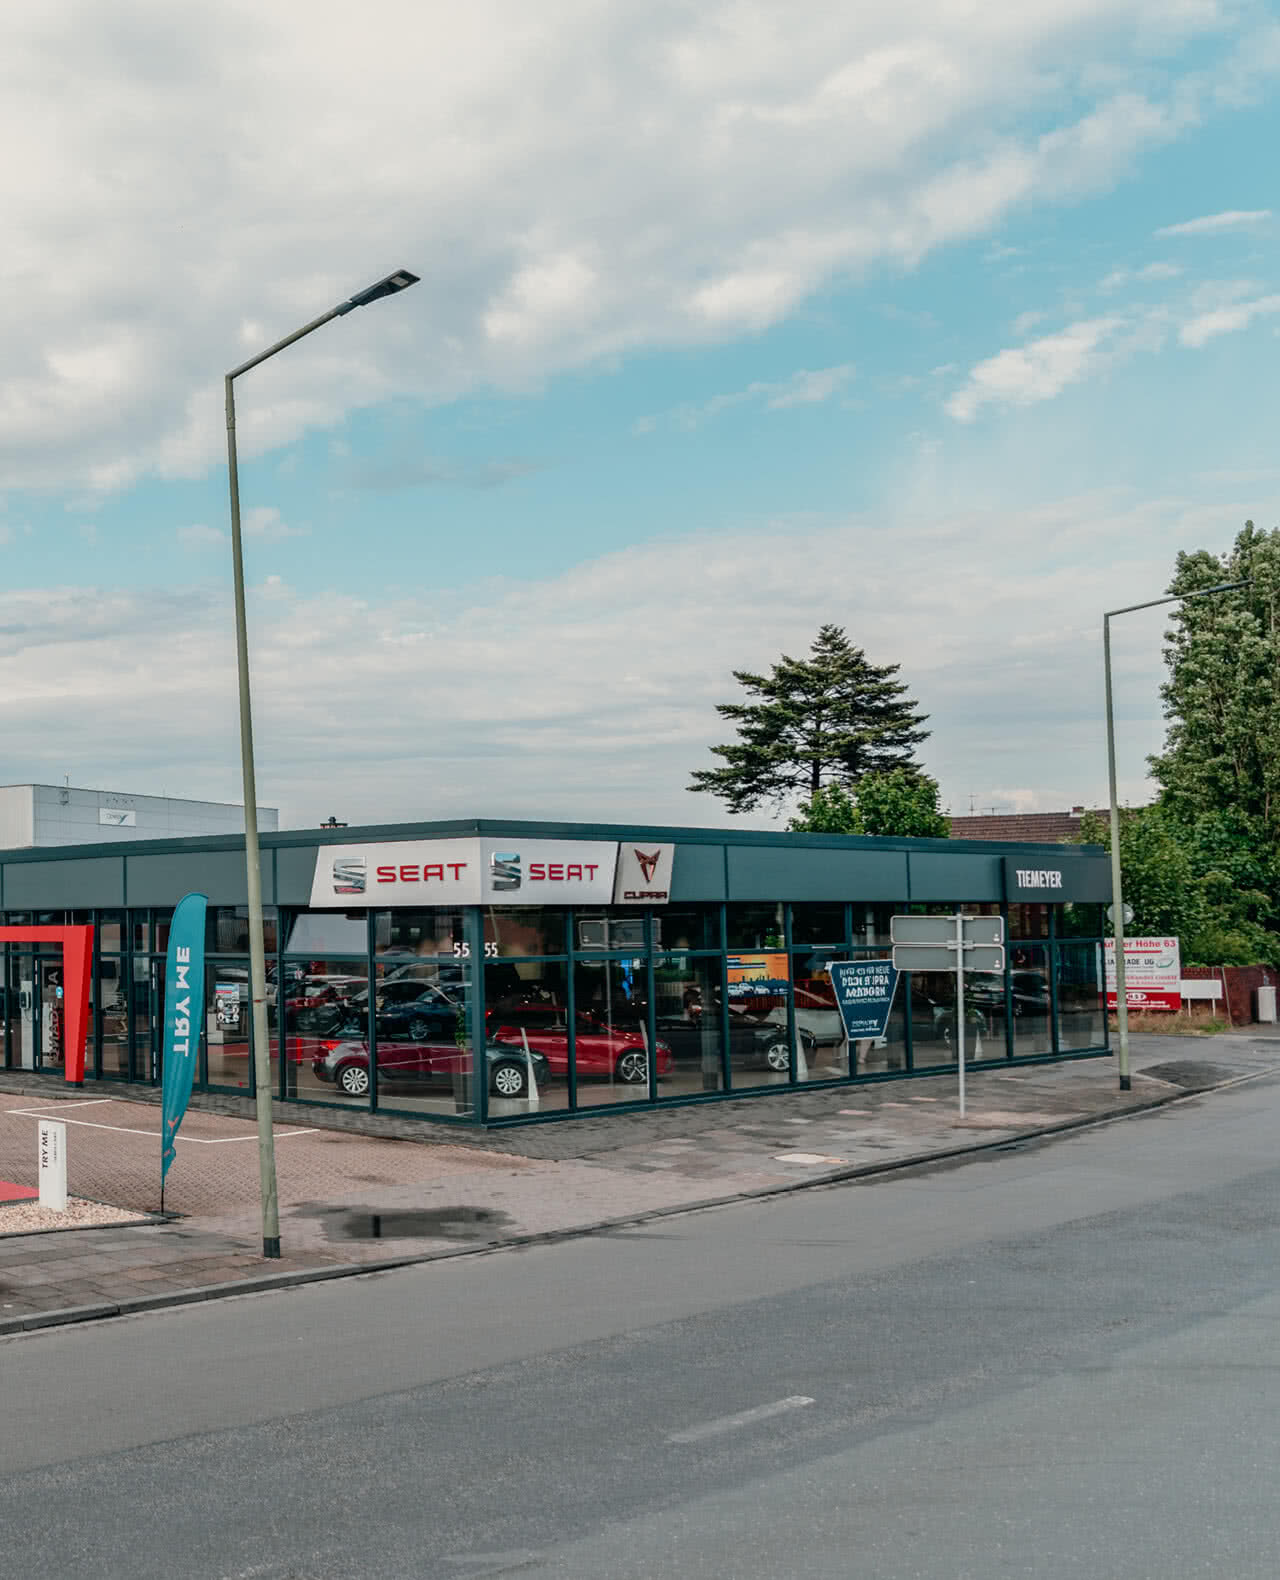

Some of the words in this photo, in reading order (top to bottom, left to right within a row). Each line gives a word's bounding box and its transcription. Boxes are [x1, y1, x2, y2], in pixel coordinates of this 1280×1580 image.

[376, 863, 468, 883] SEAT
[528, 863, 599, 881] SEAT
[1016, 870, 1062, 888] TIEMEYER
[624, 891, 668, 900] CUPRA
[453, 942, 470, 958] 55
[484, 942, 498, 958] 55
[42, 1130, 49, 1147] ME
